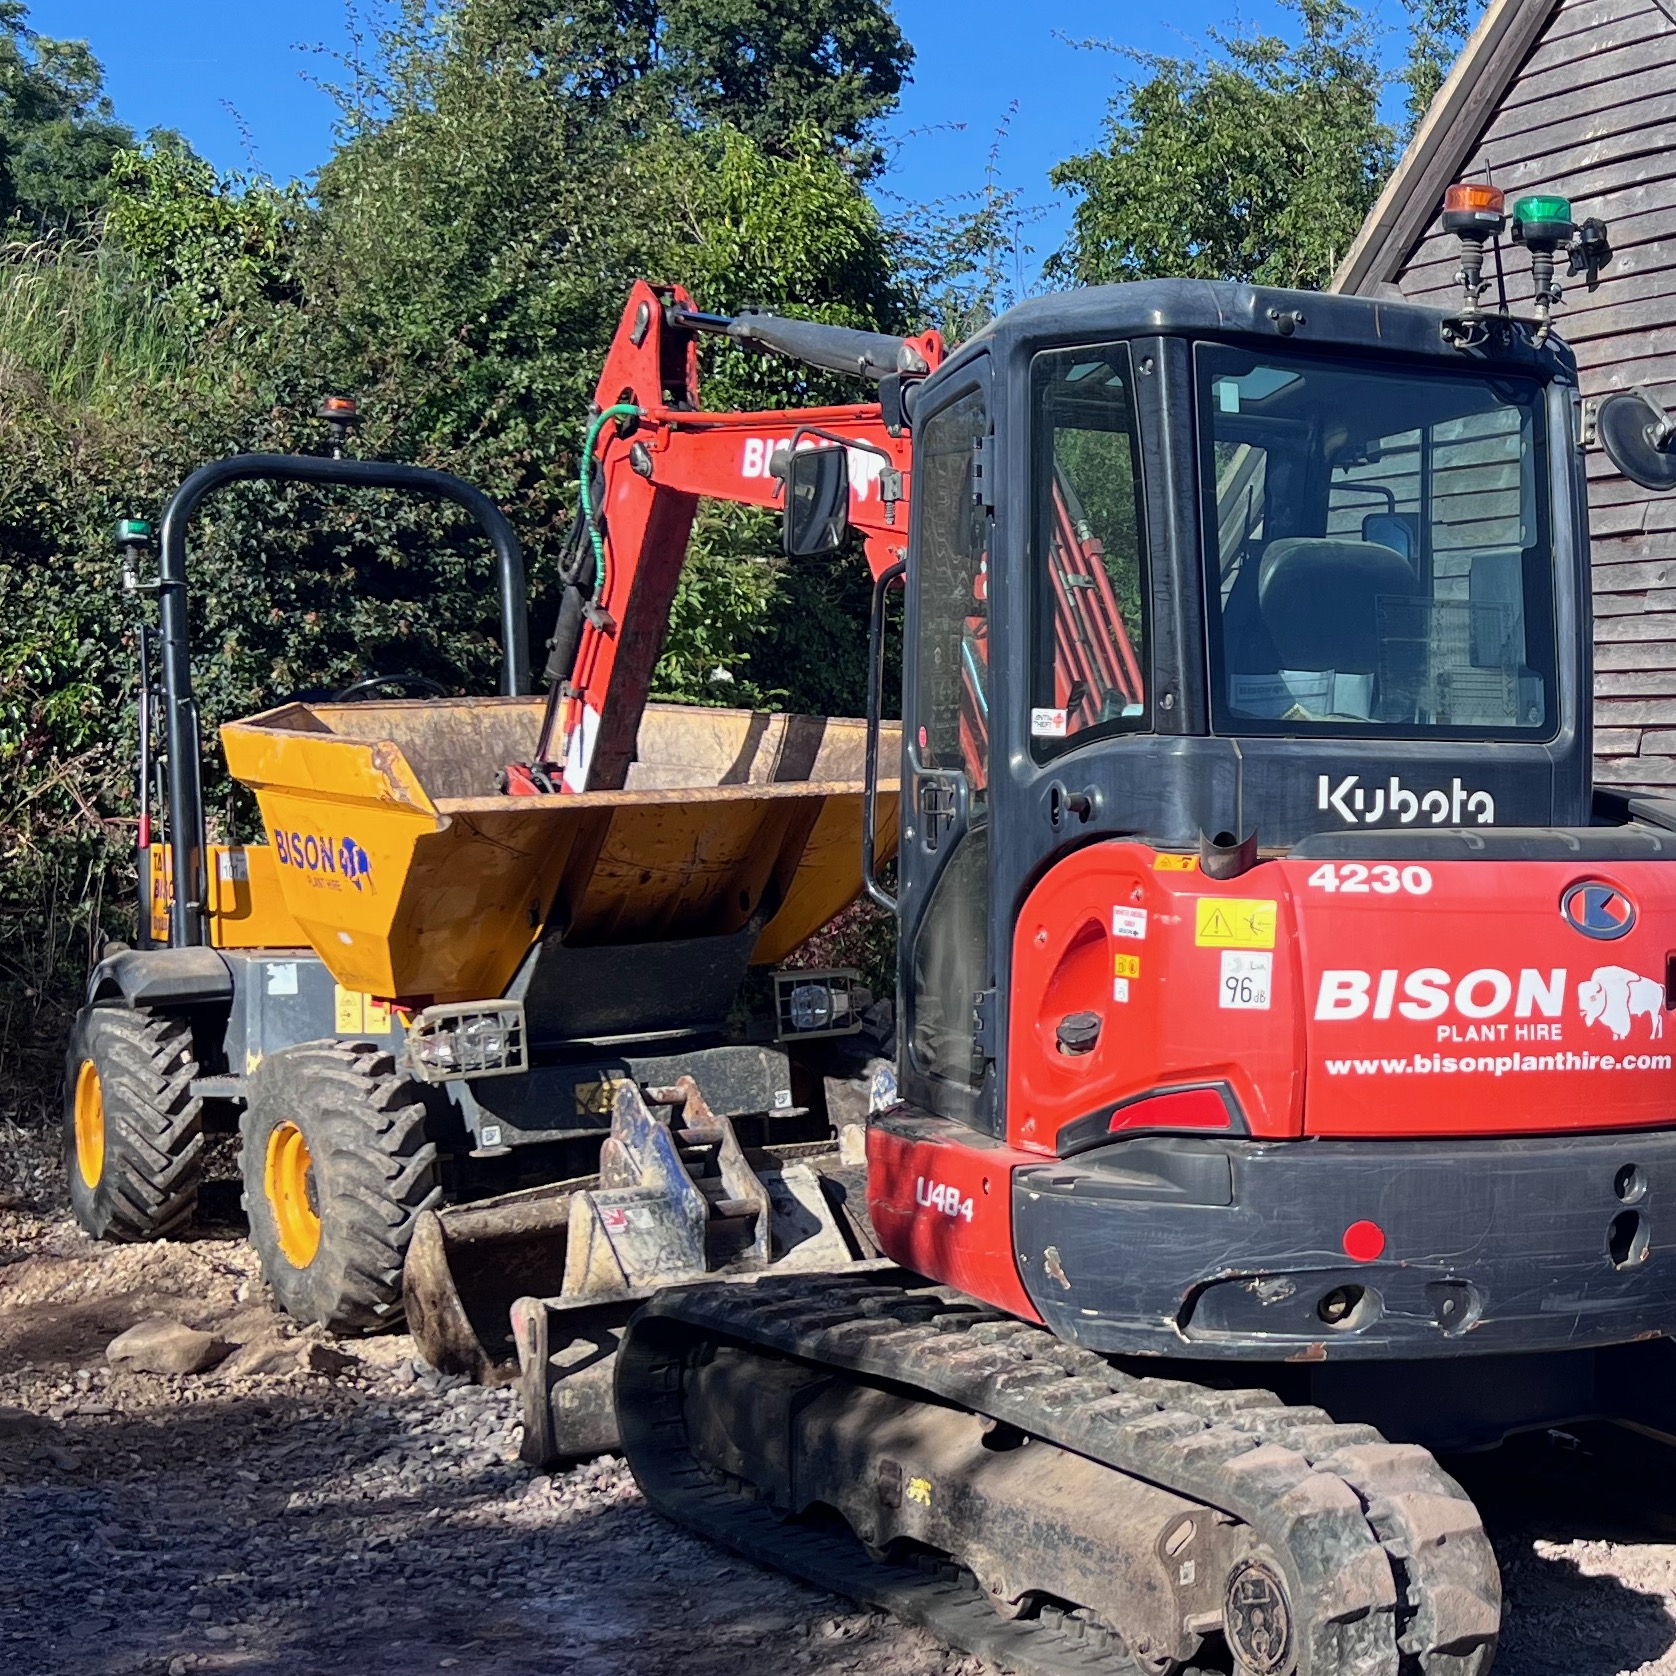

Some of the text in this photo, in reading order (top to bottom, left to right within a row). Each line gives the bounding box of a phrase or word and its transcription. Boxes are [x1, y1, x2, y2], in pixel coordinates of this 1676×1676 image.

[1318, 775, 1494, 824] Kubota
[274, 828, 336, 872] BISON
[1308, 864, 1433, 895] 4230
[1225, 976, 1253, 1003] 96
[1253, 989, 1266, 1003] dB
[1313, 968, 1567, 1021] BISON
[1437, 1023, 1563, 1043] PLANT HIRE
[1325, 1051, 1672, 1076] www.bisonplanthire.com
